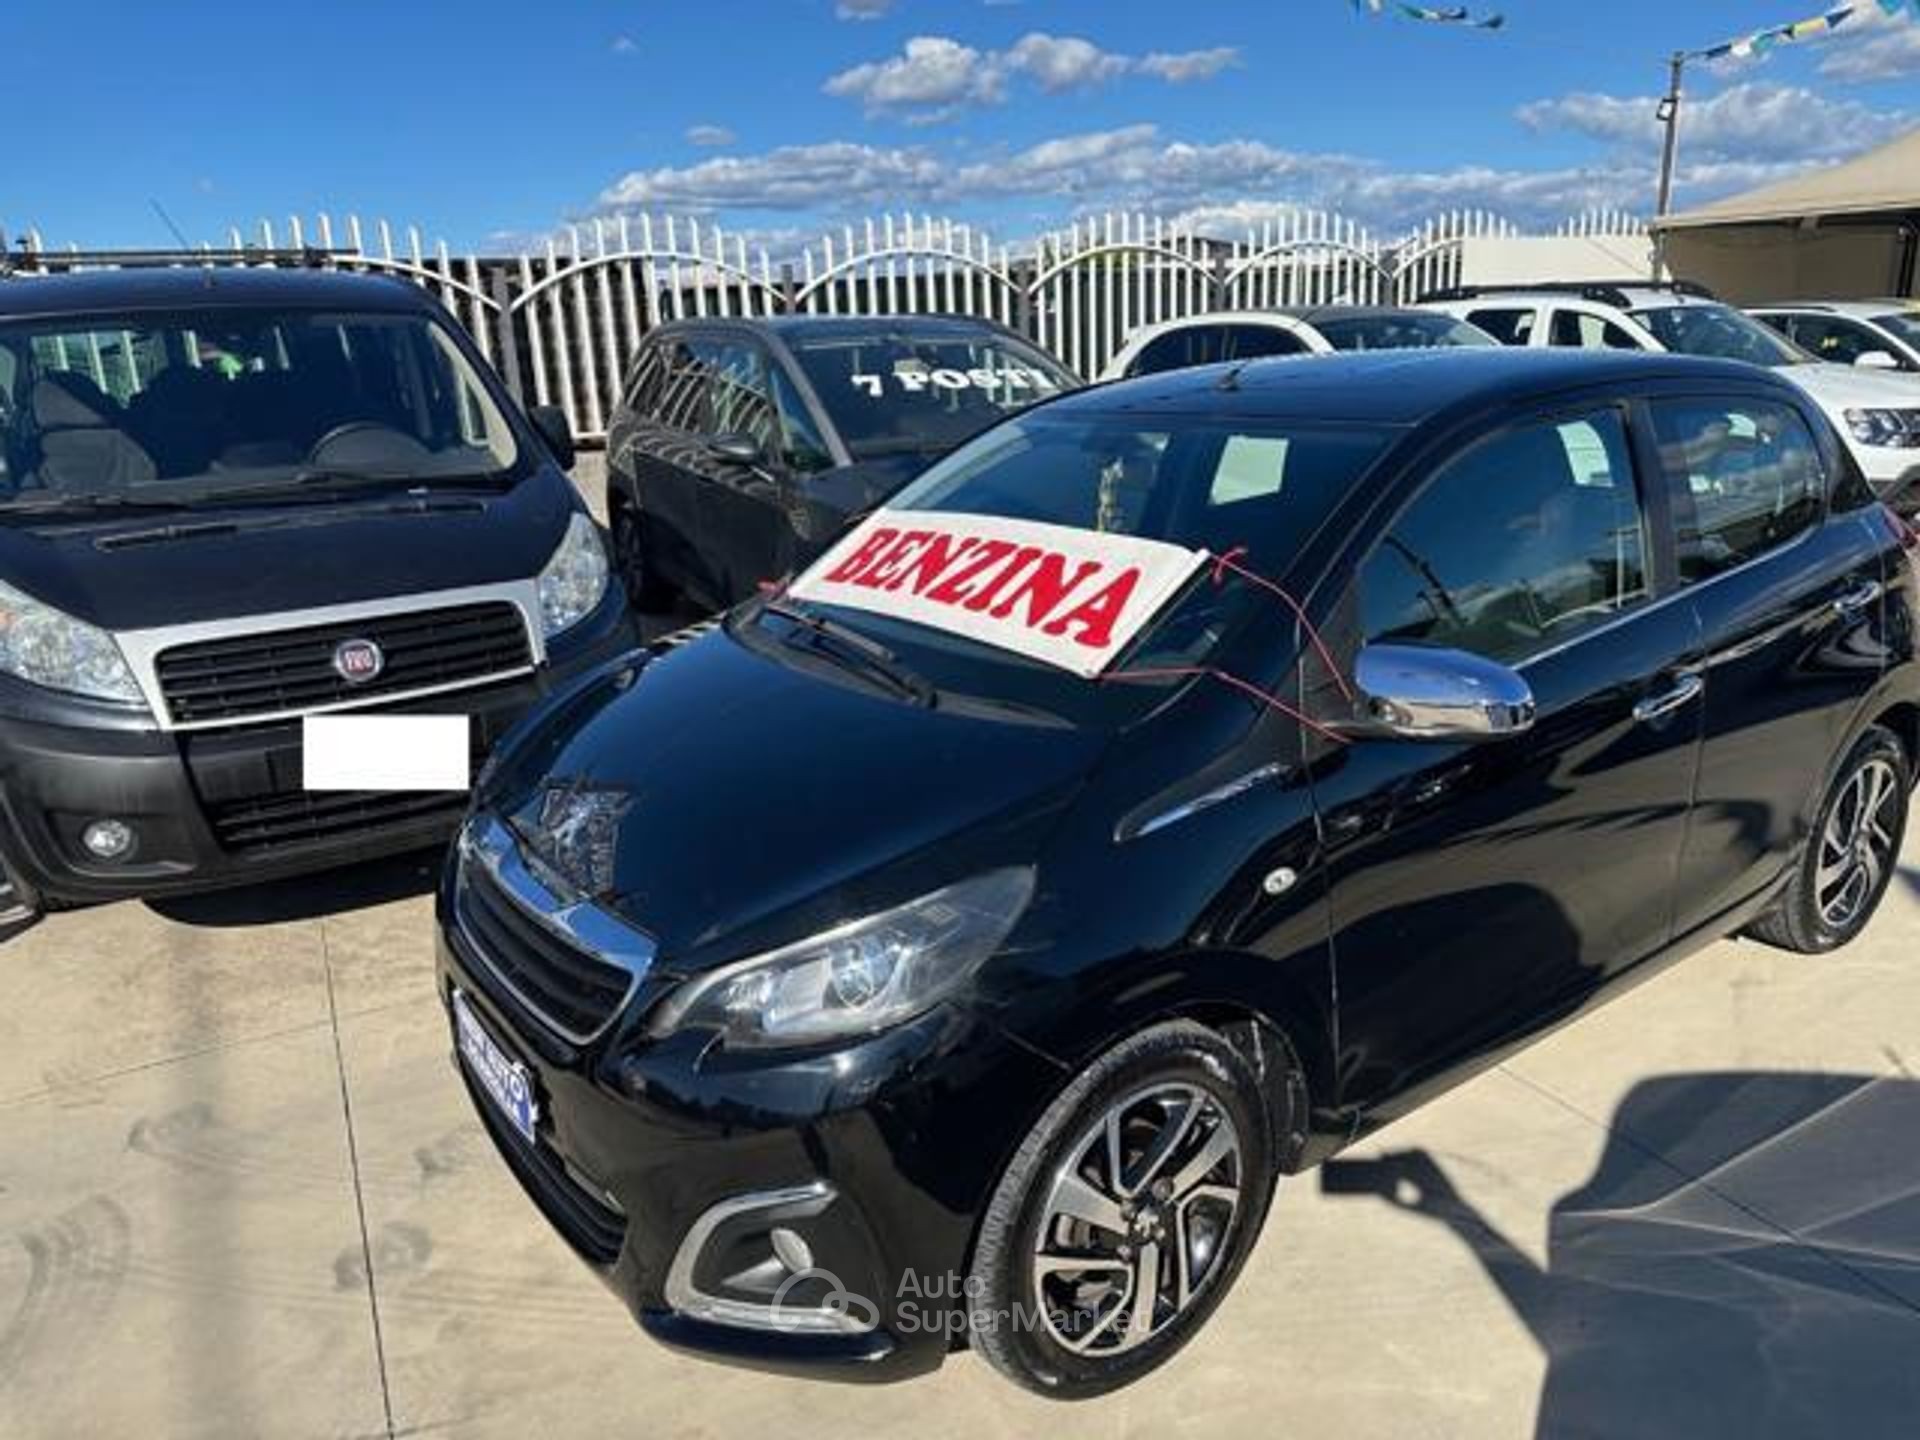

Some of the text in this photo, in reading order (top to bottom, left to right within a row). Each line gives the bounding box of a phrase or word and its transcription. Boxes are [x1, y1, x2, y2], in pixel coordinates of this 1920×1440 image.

[852, 367, 1056, 397] 7 POSTI
[823, 528, 1141, 649] BENZINA
